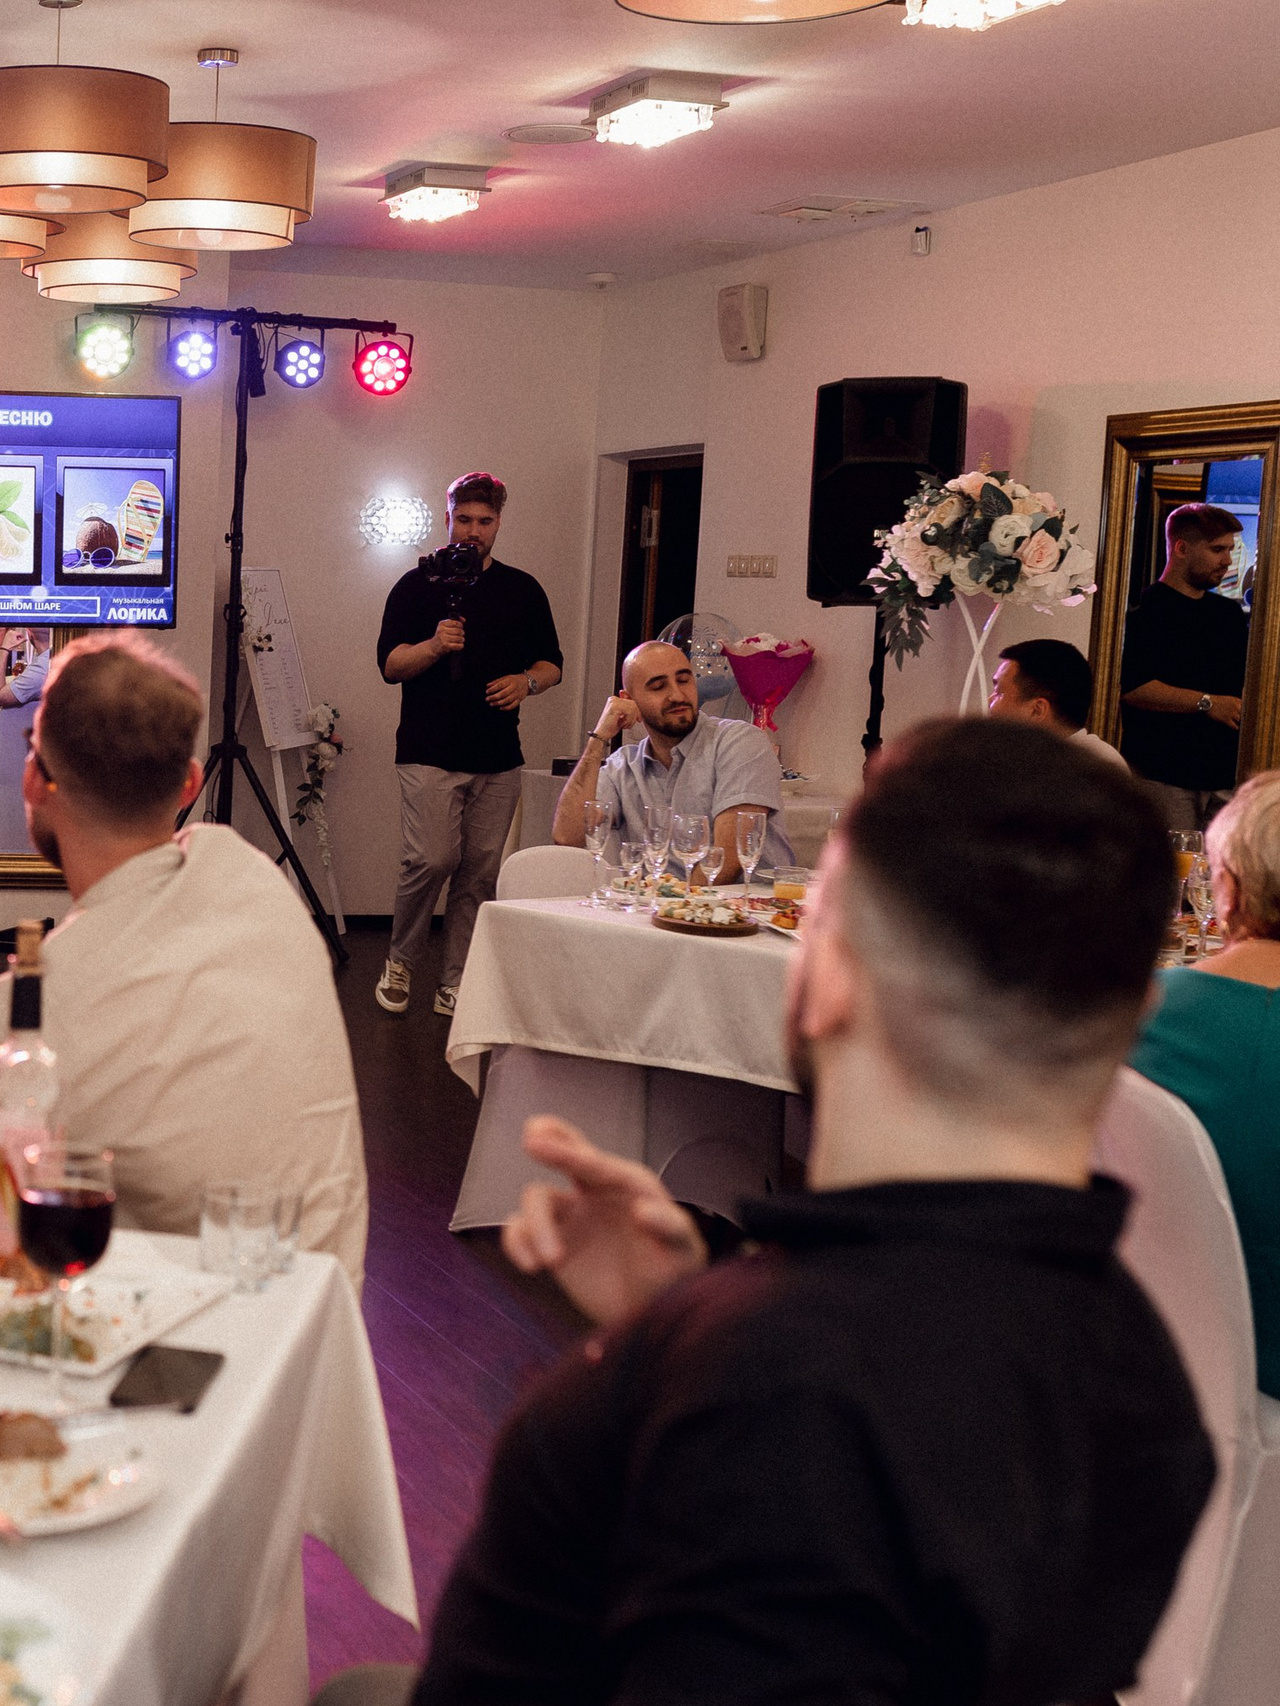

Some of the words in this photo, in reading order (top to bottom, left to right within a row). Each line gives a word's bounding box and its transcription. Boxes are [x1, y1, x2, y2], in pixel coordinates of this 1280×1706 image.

[112, 597, 164, 606] музыкальная
[34, 602, 61, 611] ШАРЕ
[107, 607, 168, 621] ЛОГИКА
